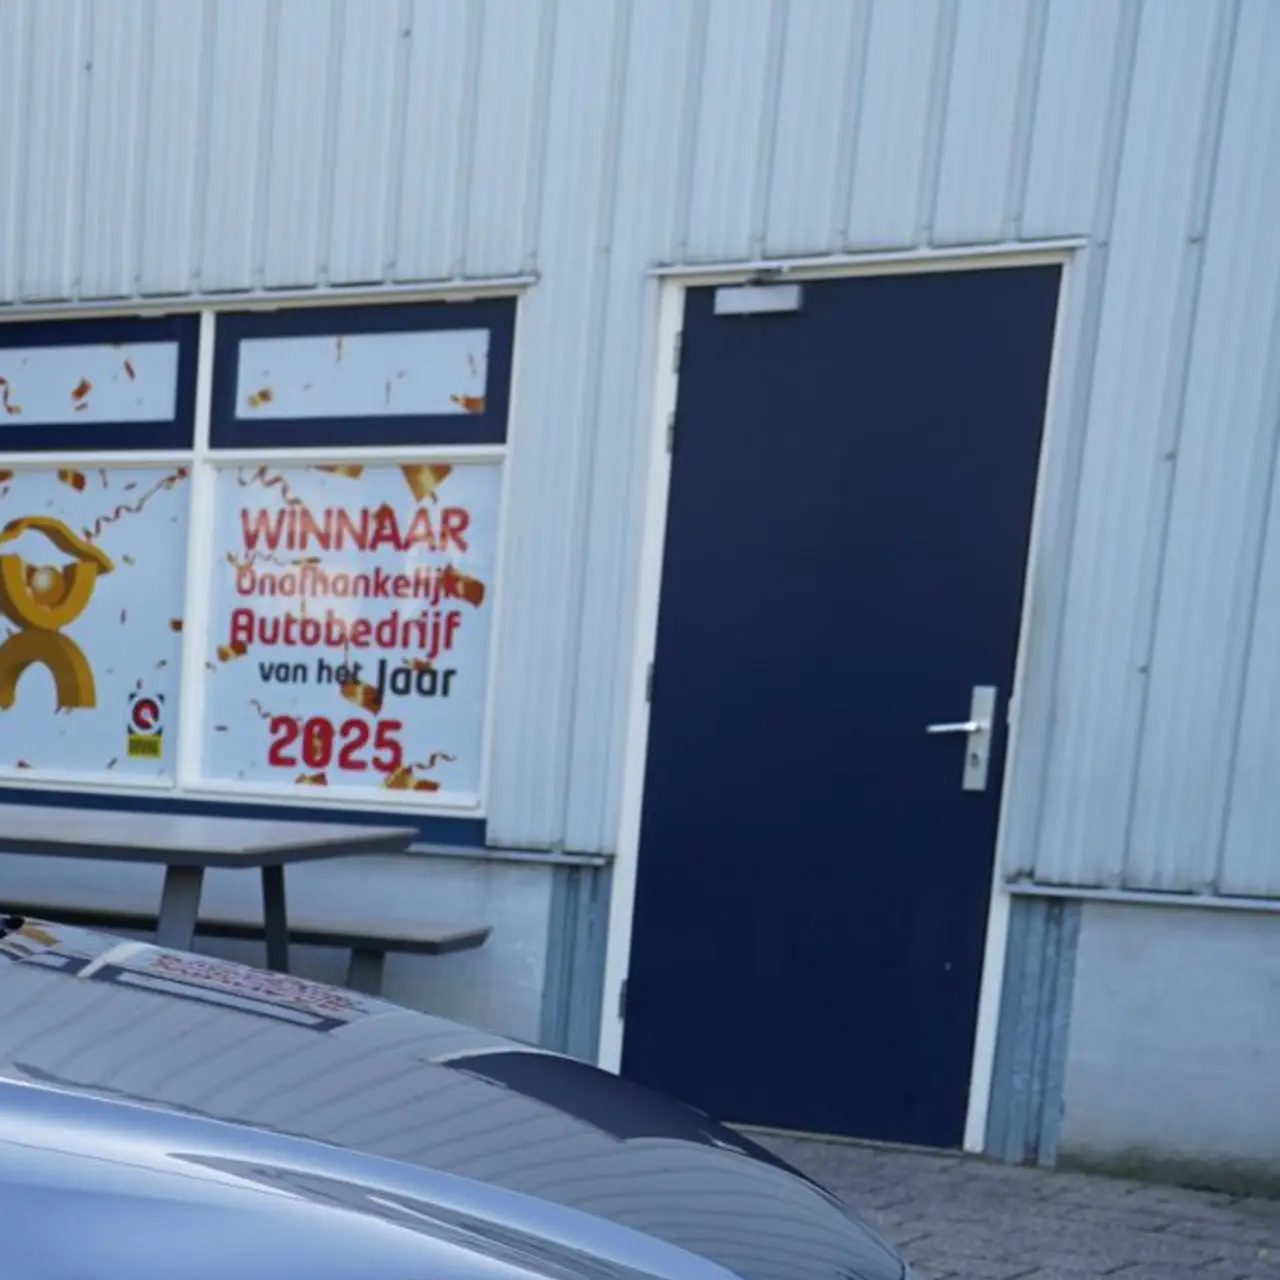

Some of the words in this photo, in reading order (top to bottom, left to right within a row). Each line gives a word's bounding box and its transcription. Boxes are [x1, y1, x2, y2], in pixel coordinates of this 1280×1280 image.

[241, 505, 470, 552] WINNAAR
[230, 608, 461, 659] Autobedrijf
[259, 661, 307, 684] van
[316, 658, 362, 685] het
[267, 715, 404, 772] 2025
